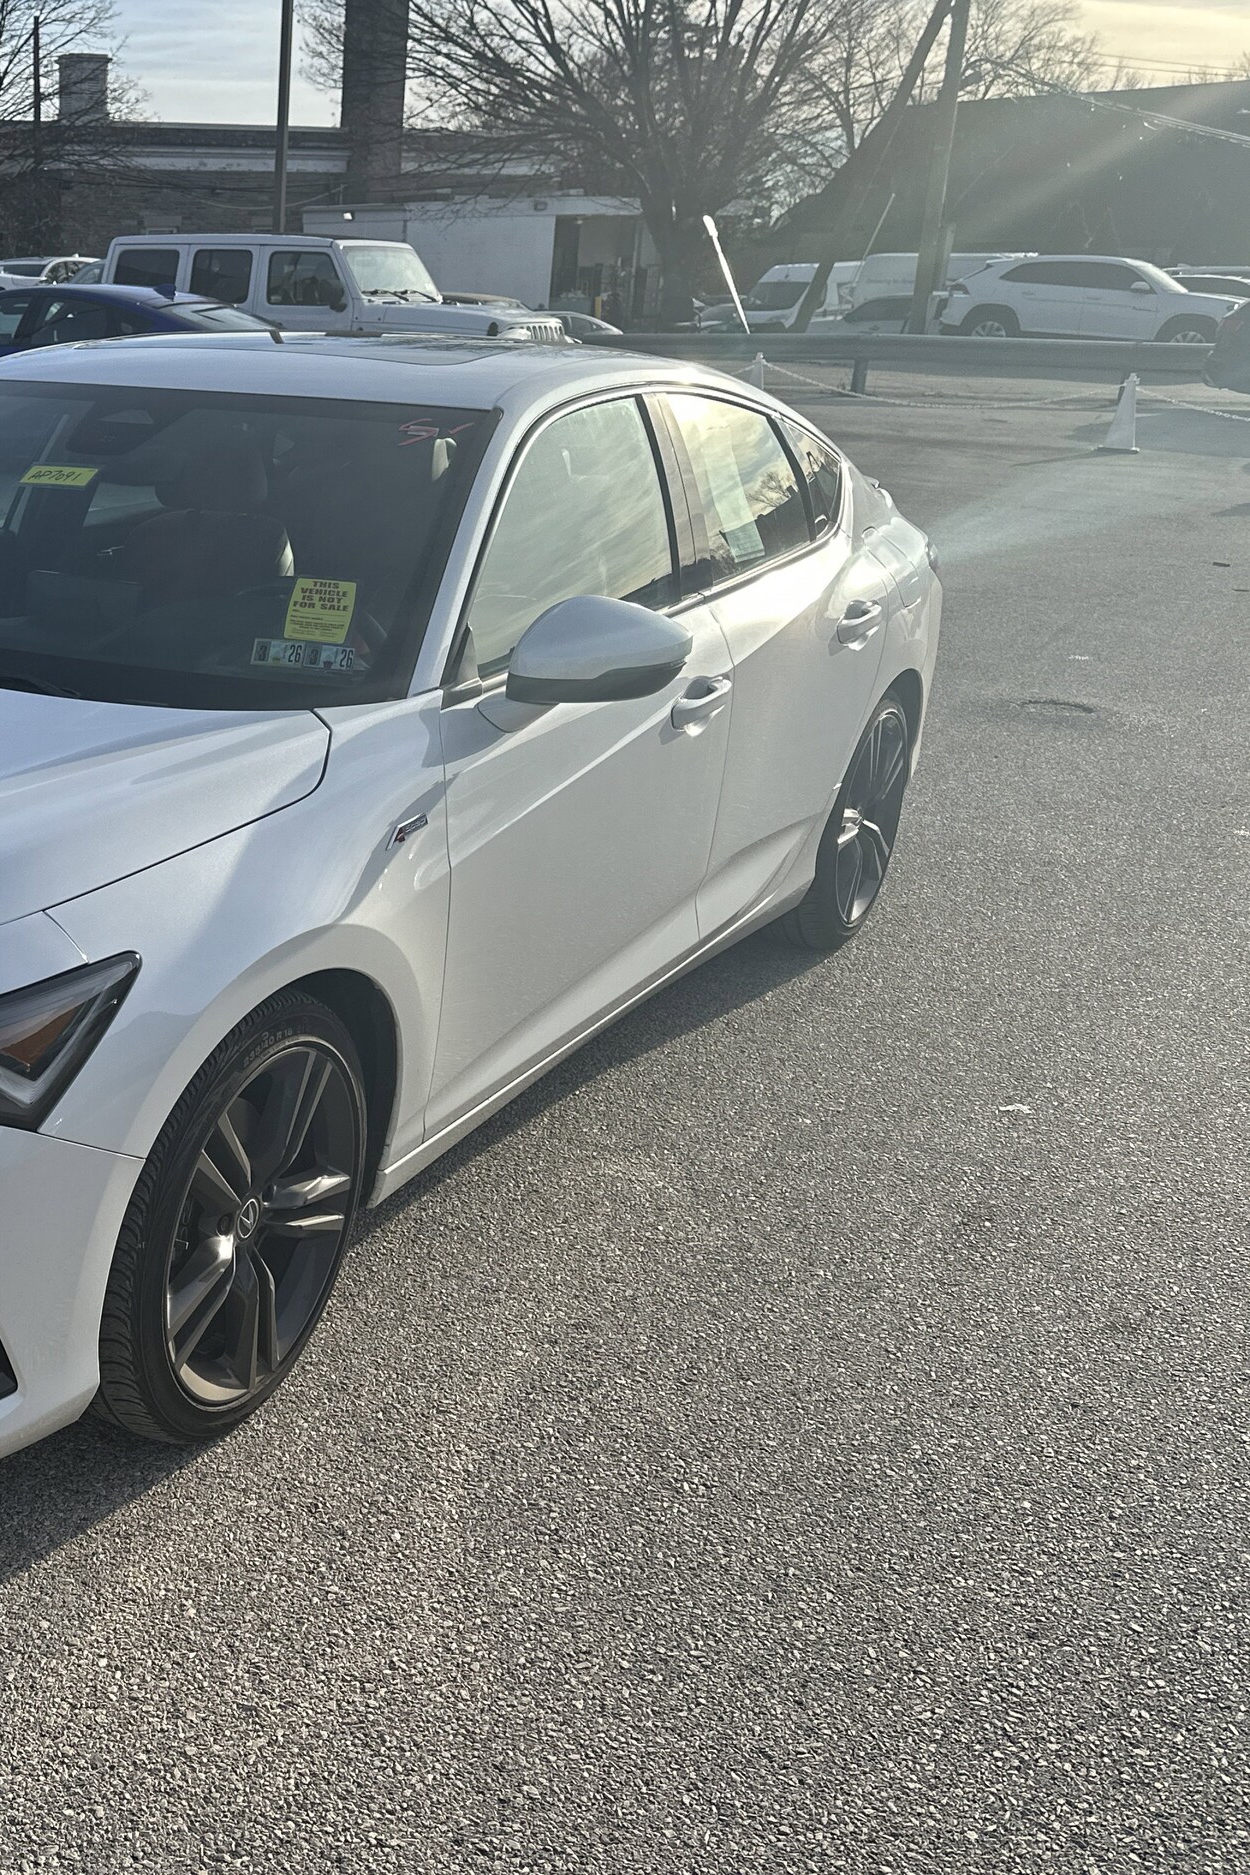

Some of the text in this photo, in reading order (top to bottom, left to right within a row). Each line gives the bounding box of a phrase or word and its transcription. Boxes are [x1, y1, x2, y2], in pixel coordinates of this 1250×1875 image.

[312, 581, 340, 589] THIS
[301, 587, 349, 597] VEHICLE
[318, 596, 343, 604] NOT
[293, 601, 349, 611] FOR SALE
[288, 644, 302, 663] 26
[339, 649, 354, 668] 26
